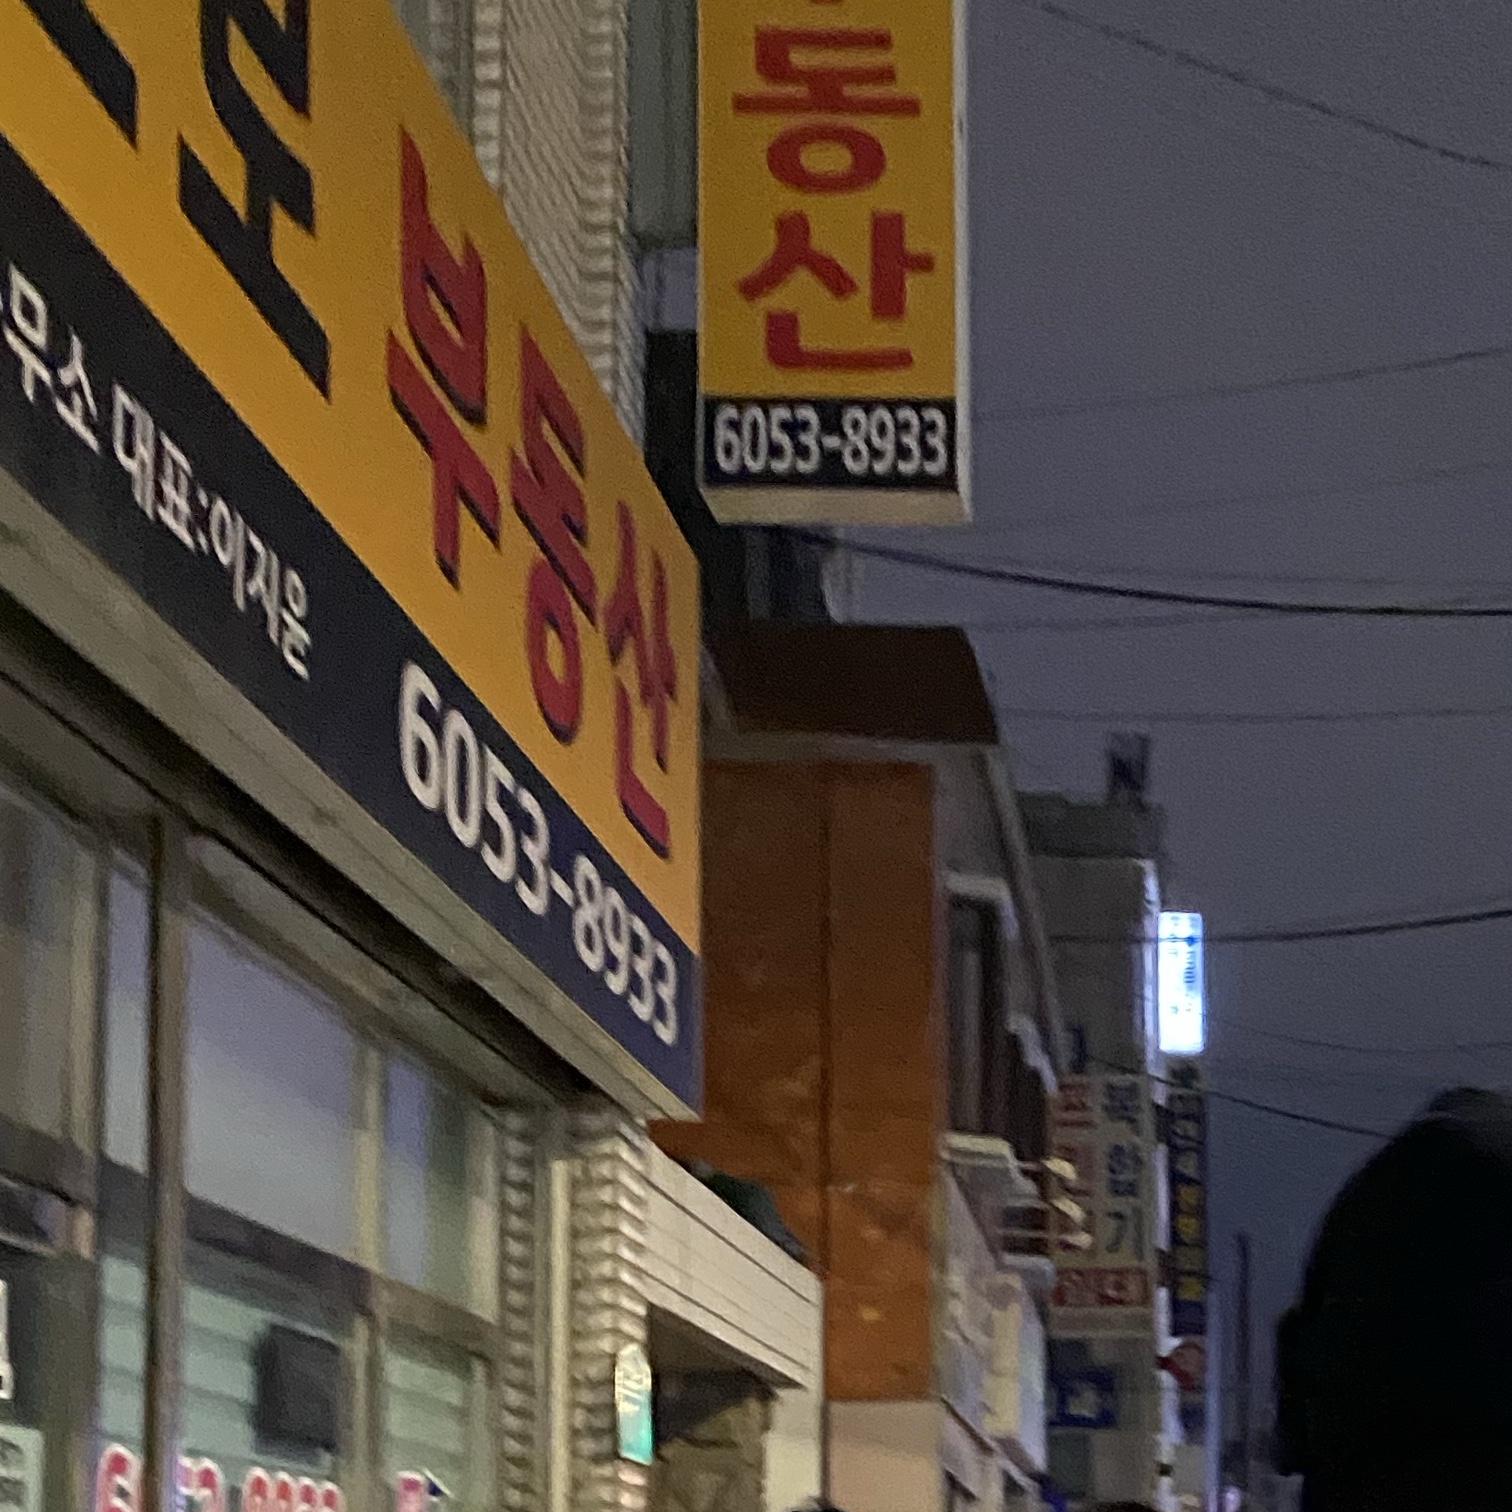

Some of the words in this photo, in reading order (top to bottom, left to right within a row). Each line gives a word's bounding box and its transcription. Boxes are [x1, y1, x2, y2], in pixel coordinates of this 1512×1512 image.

[0, 262, 101, 456] 무소
[733, 0, 935, 372] 동산
[18, 0, 332, 404] 로
[387, 122, 677, 863] 부동산
[712, 405, 947, 475] 6053-8933
[400, 661, 678, 1046] 6053-8933
